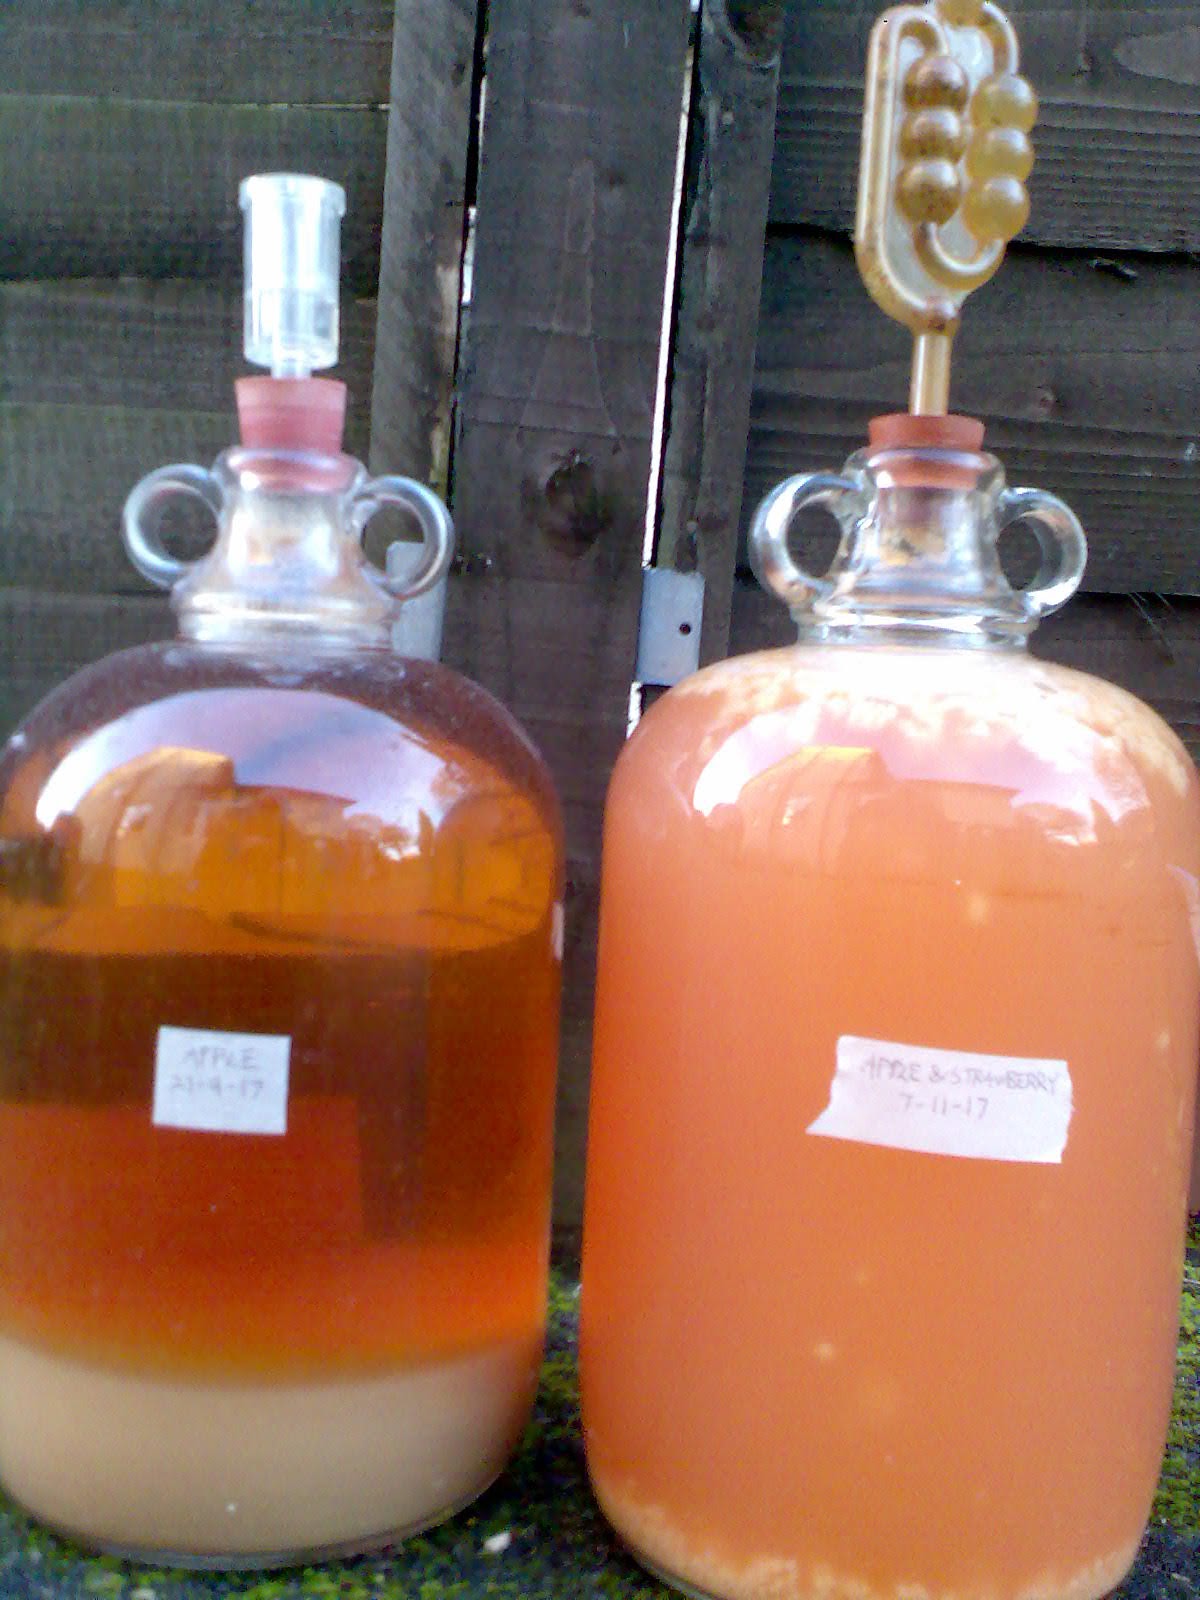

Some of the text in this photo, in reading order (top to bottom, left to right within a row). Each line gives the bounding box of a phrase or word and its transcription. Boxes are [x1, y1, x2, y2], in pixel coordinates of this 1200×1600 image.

[180, 1045, 260, 1070] APPLE
[928, 1064, 945, 1083] &
[898, 1091, 989, 1119] 7-11-17
